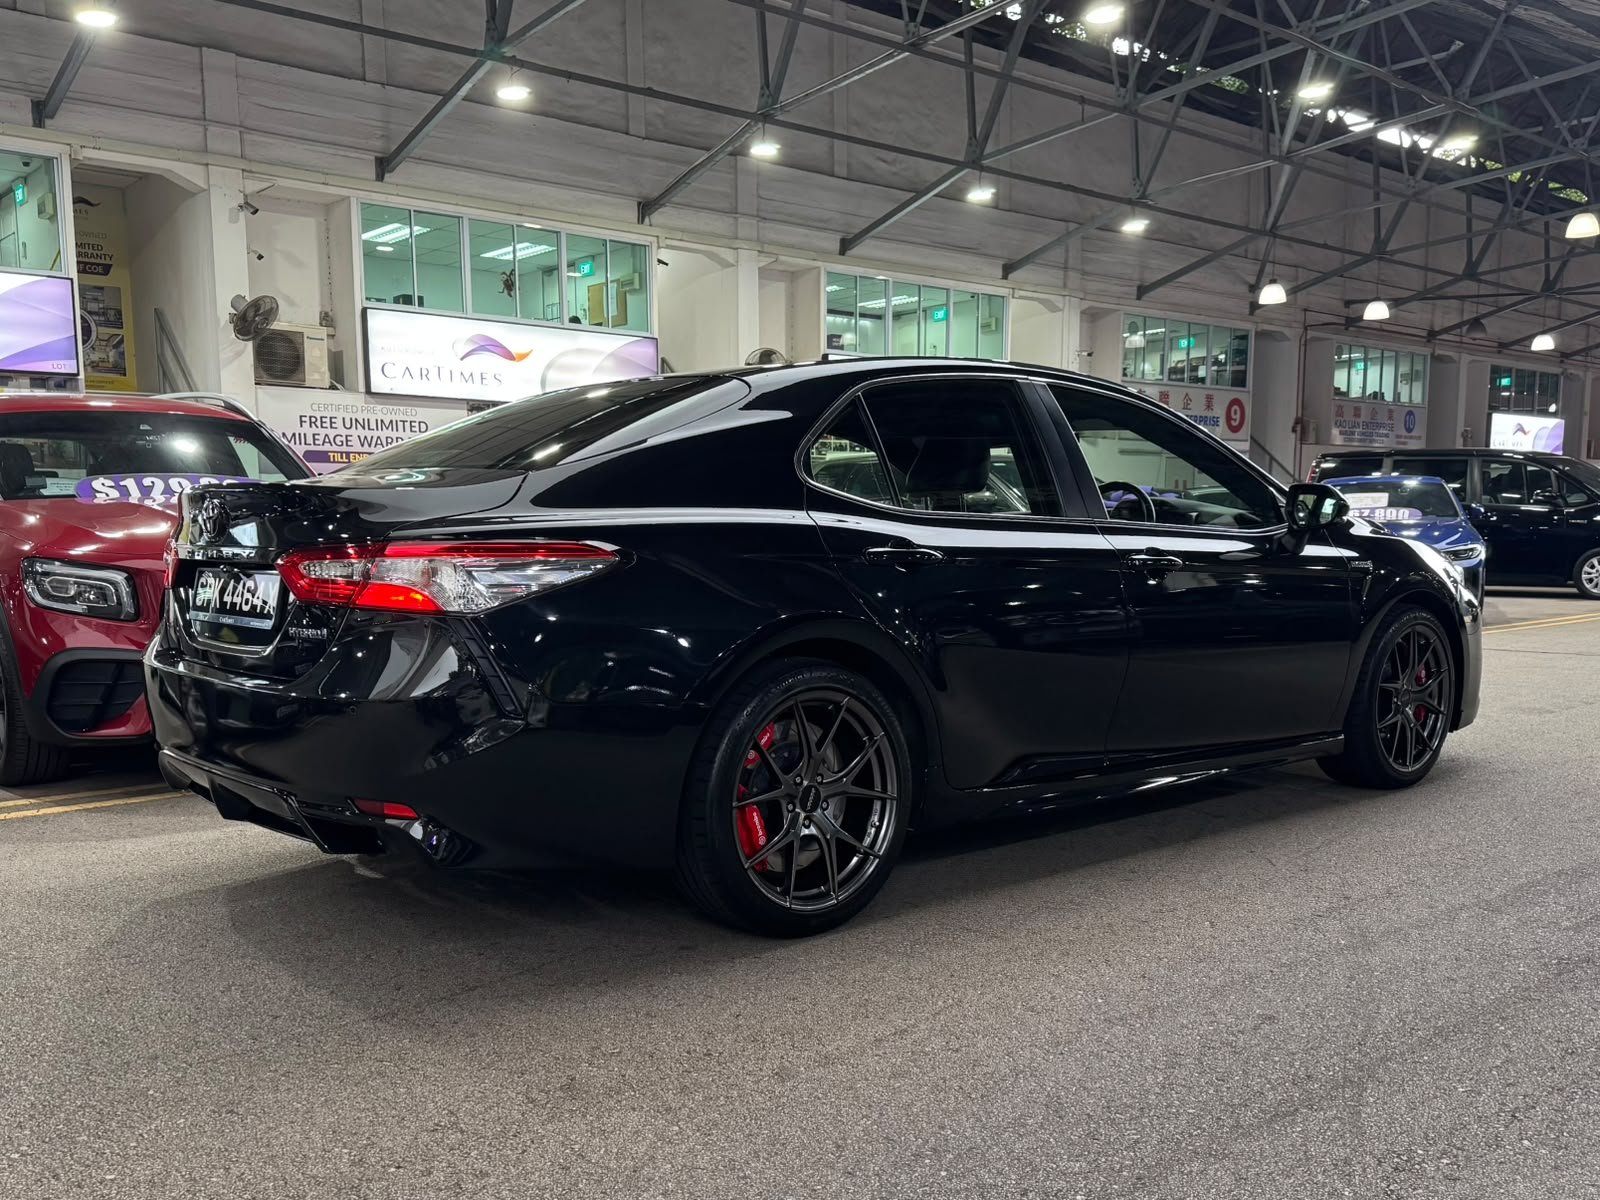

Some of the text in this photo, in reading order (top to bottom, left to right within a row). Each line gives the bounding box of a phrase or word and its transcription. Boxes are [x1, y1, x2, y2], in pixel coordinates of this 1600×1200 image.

[76, 242, 103, 251] MITED
[77, 250, 113, 261] RRANTY
[86, 264, 104, 273] COE
[310, 402, 417, 417] CERTIFIED PRE-OWNED
[1230, 405, 1240, 426] 9
[299, 414, 428, 434] FREE UNLIMITED
[1187, 414, 1220, 427] ERPRISE
[1362, 421, 1394, 432] ENTERPRISE
[1405, 413, 1415, 429] 10
[282, 432, 353, 448] MILEAGE
[328, 452, 348, 462] TILL
